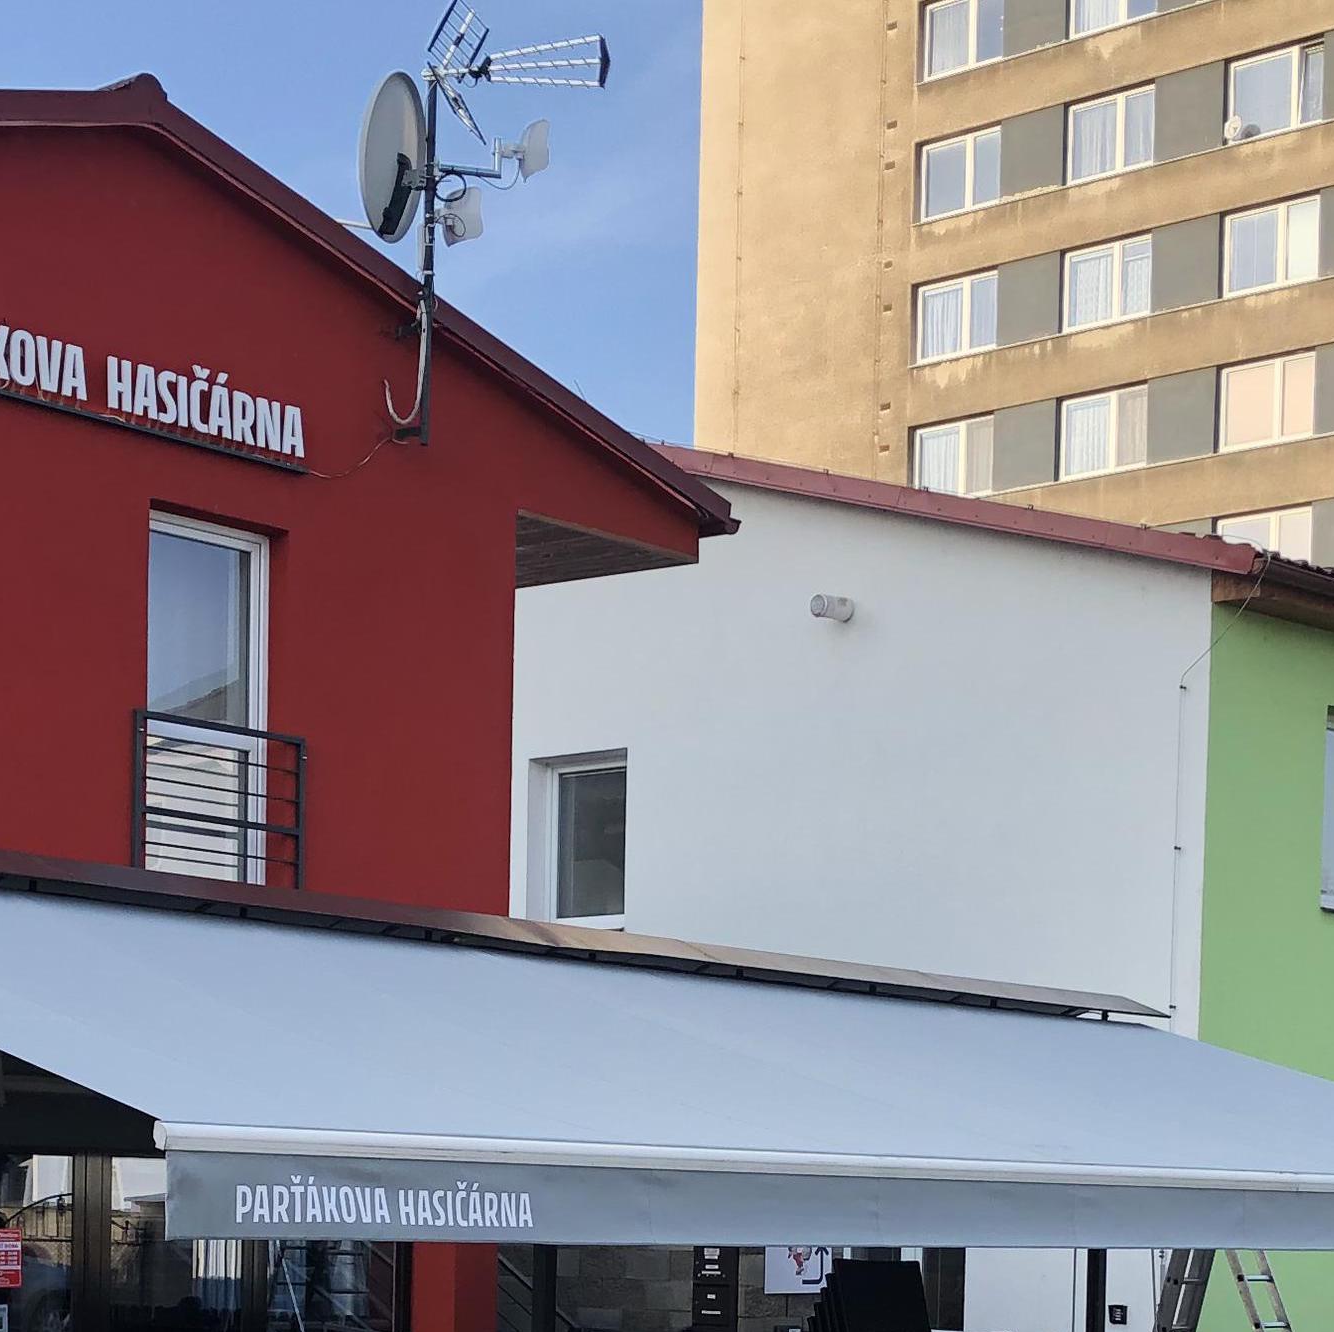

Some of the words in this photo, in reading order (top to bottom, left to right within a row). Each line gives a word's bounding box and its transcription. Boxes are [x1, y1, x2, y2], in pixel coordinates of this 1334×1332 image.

[106, 355, 305, 458] HASIČÁRNA
[235, 1175, 391, 1224] PARŤÁKOVA
[398, 1180, 534, 1228] HASIČÁRNA
